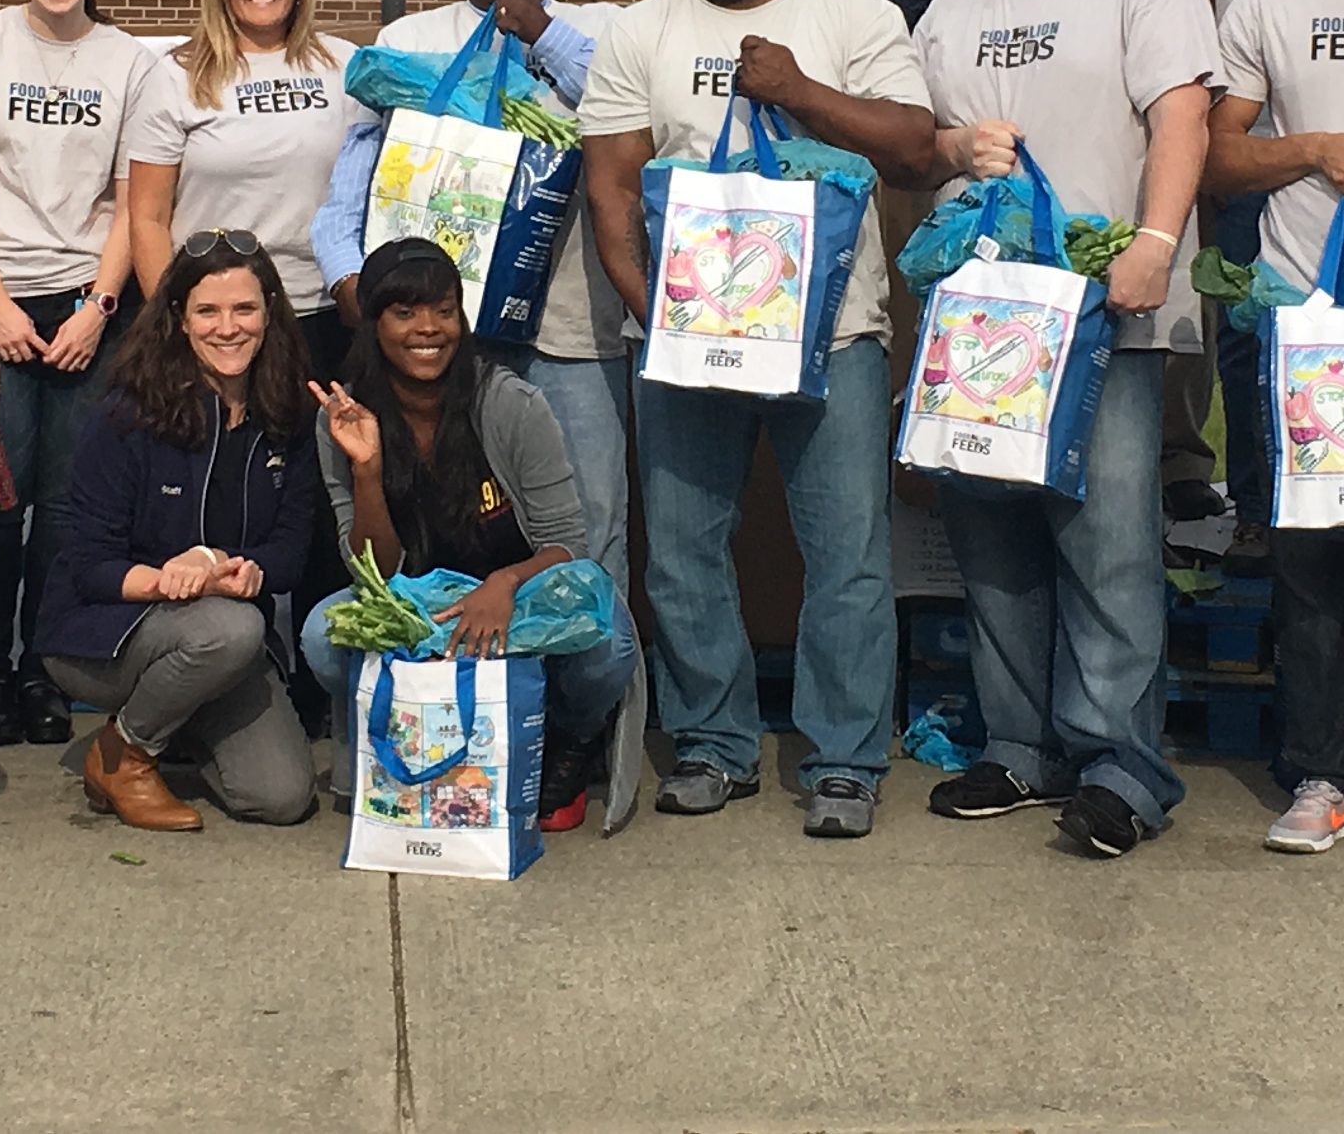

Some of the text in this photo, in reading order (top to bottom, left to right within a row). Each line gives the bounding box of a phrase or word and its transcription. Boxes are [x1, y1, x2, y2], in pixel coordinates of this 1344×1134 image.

[1029, 20, 1061, 39] LION
[976, 34, 1057, 69] FEEDS
[694, 56, 734, 72] FOOD
[9, 82, 103, 104] FOOD LION
[235, 77, 324, 97] FOOD LION
[237, 89, 330, 115] FEEDS
[8, 96, 102, 128] FEEDS
[704, 354, 744, 369] FEEDS
[951, 438, 992, 456] FEEDS
[405, 846, 443, 858] FEEDS
